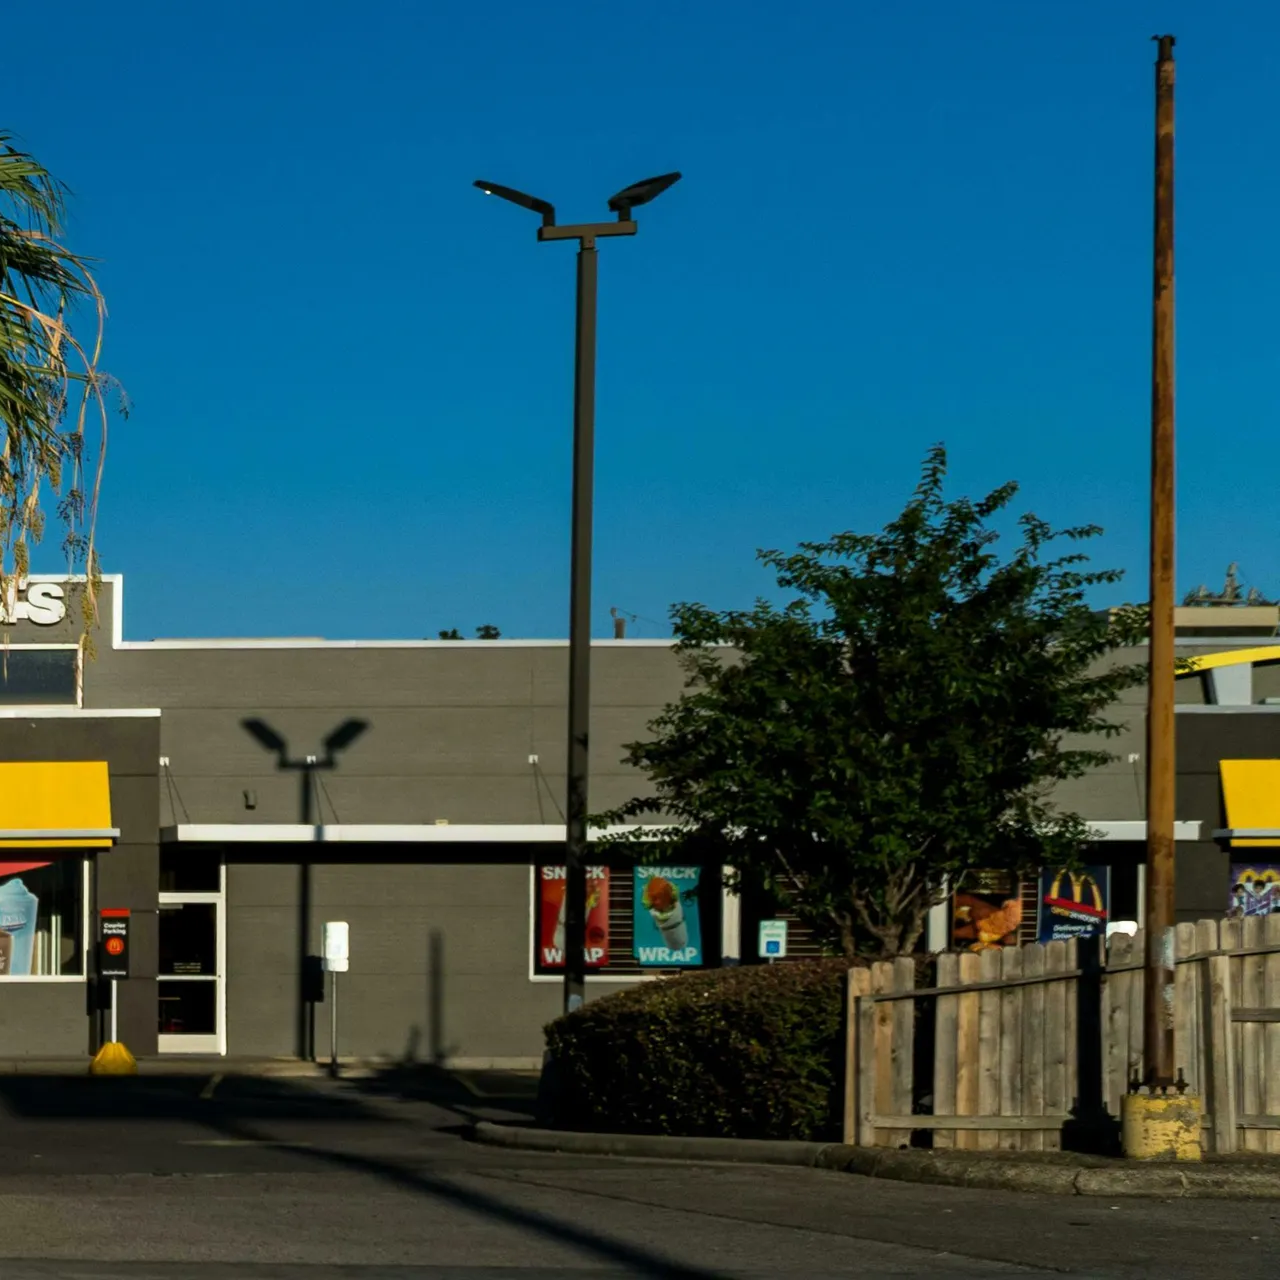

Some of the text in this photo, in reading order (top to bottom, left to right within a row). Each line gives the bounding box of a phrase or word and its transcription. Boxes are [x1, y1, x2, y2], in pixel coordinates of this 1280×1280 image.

[542, 866, 605, 880] SNCK
[637, 866, 697, 880] SNACK
[103, 928, 127, 936] Parking
[544, 948, 605, 964] WP
[639, 947, 698, 963] WRAP
